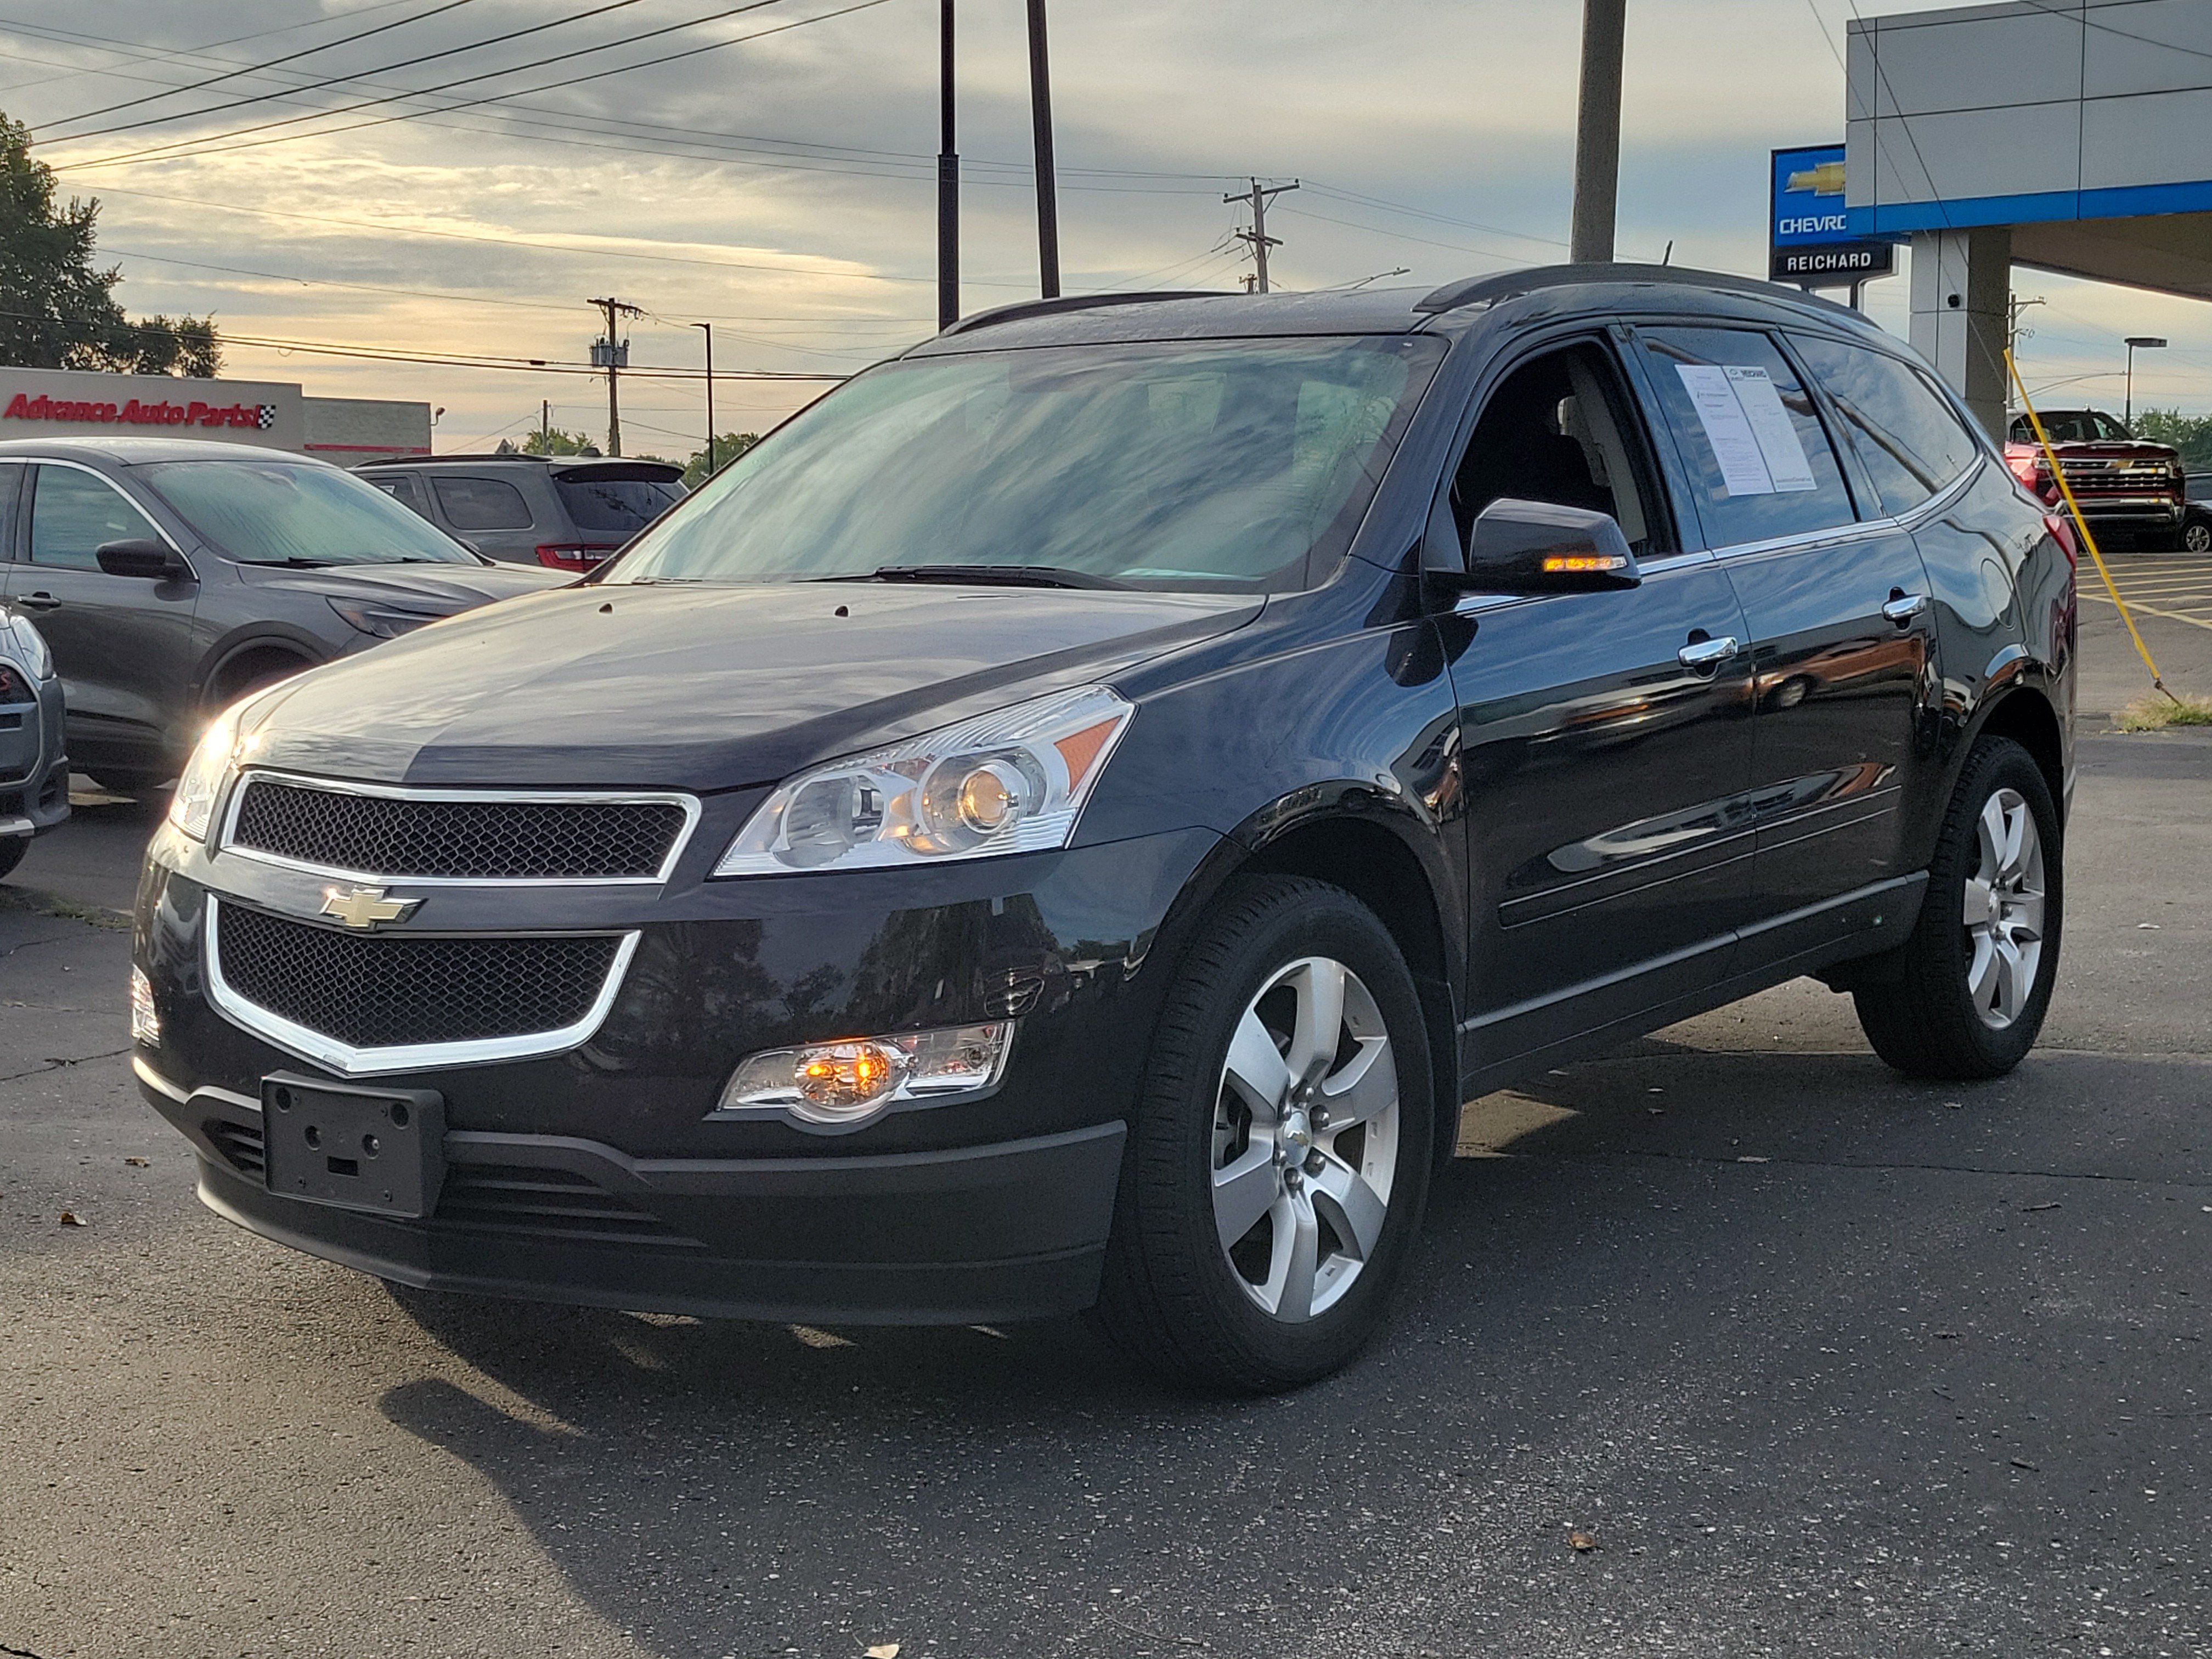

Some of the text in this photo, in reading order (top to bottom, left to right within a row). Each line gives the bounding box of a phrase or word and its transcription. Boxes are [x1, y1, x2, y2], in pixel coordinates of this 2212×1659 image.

[1787, 252, 1871, 271] REICHARD
[3, 393, 256, 427] Advance Auto Parts
